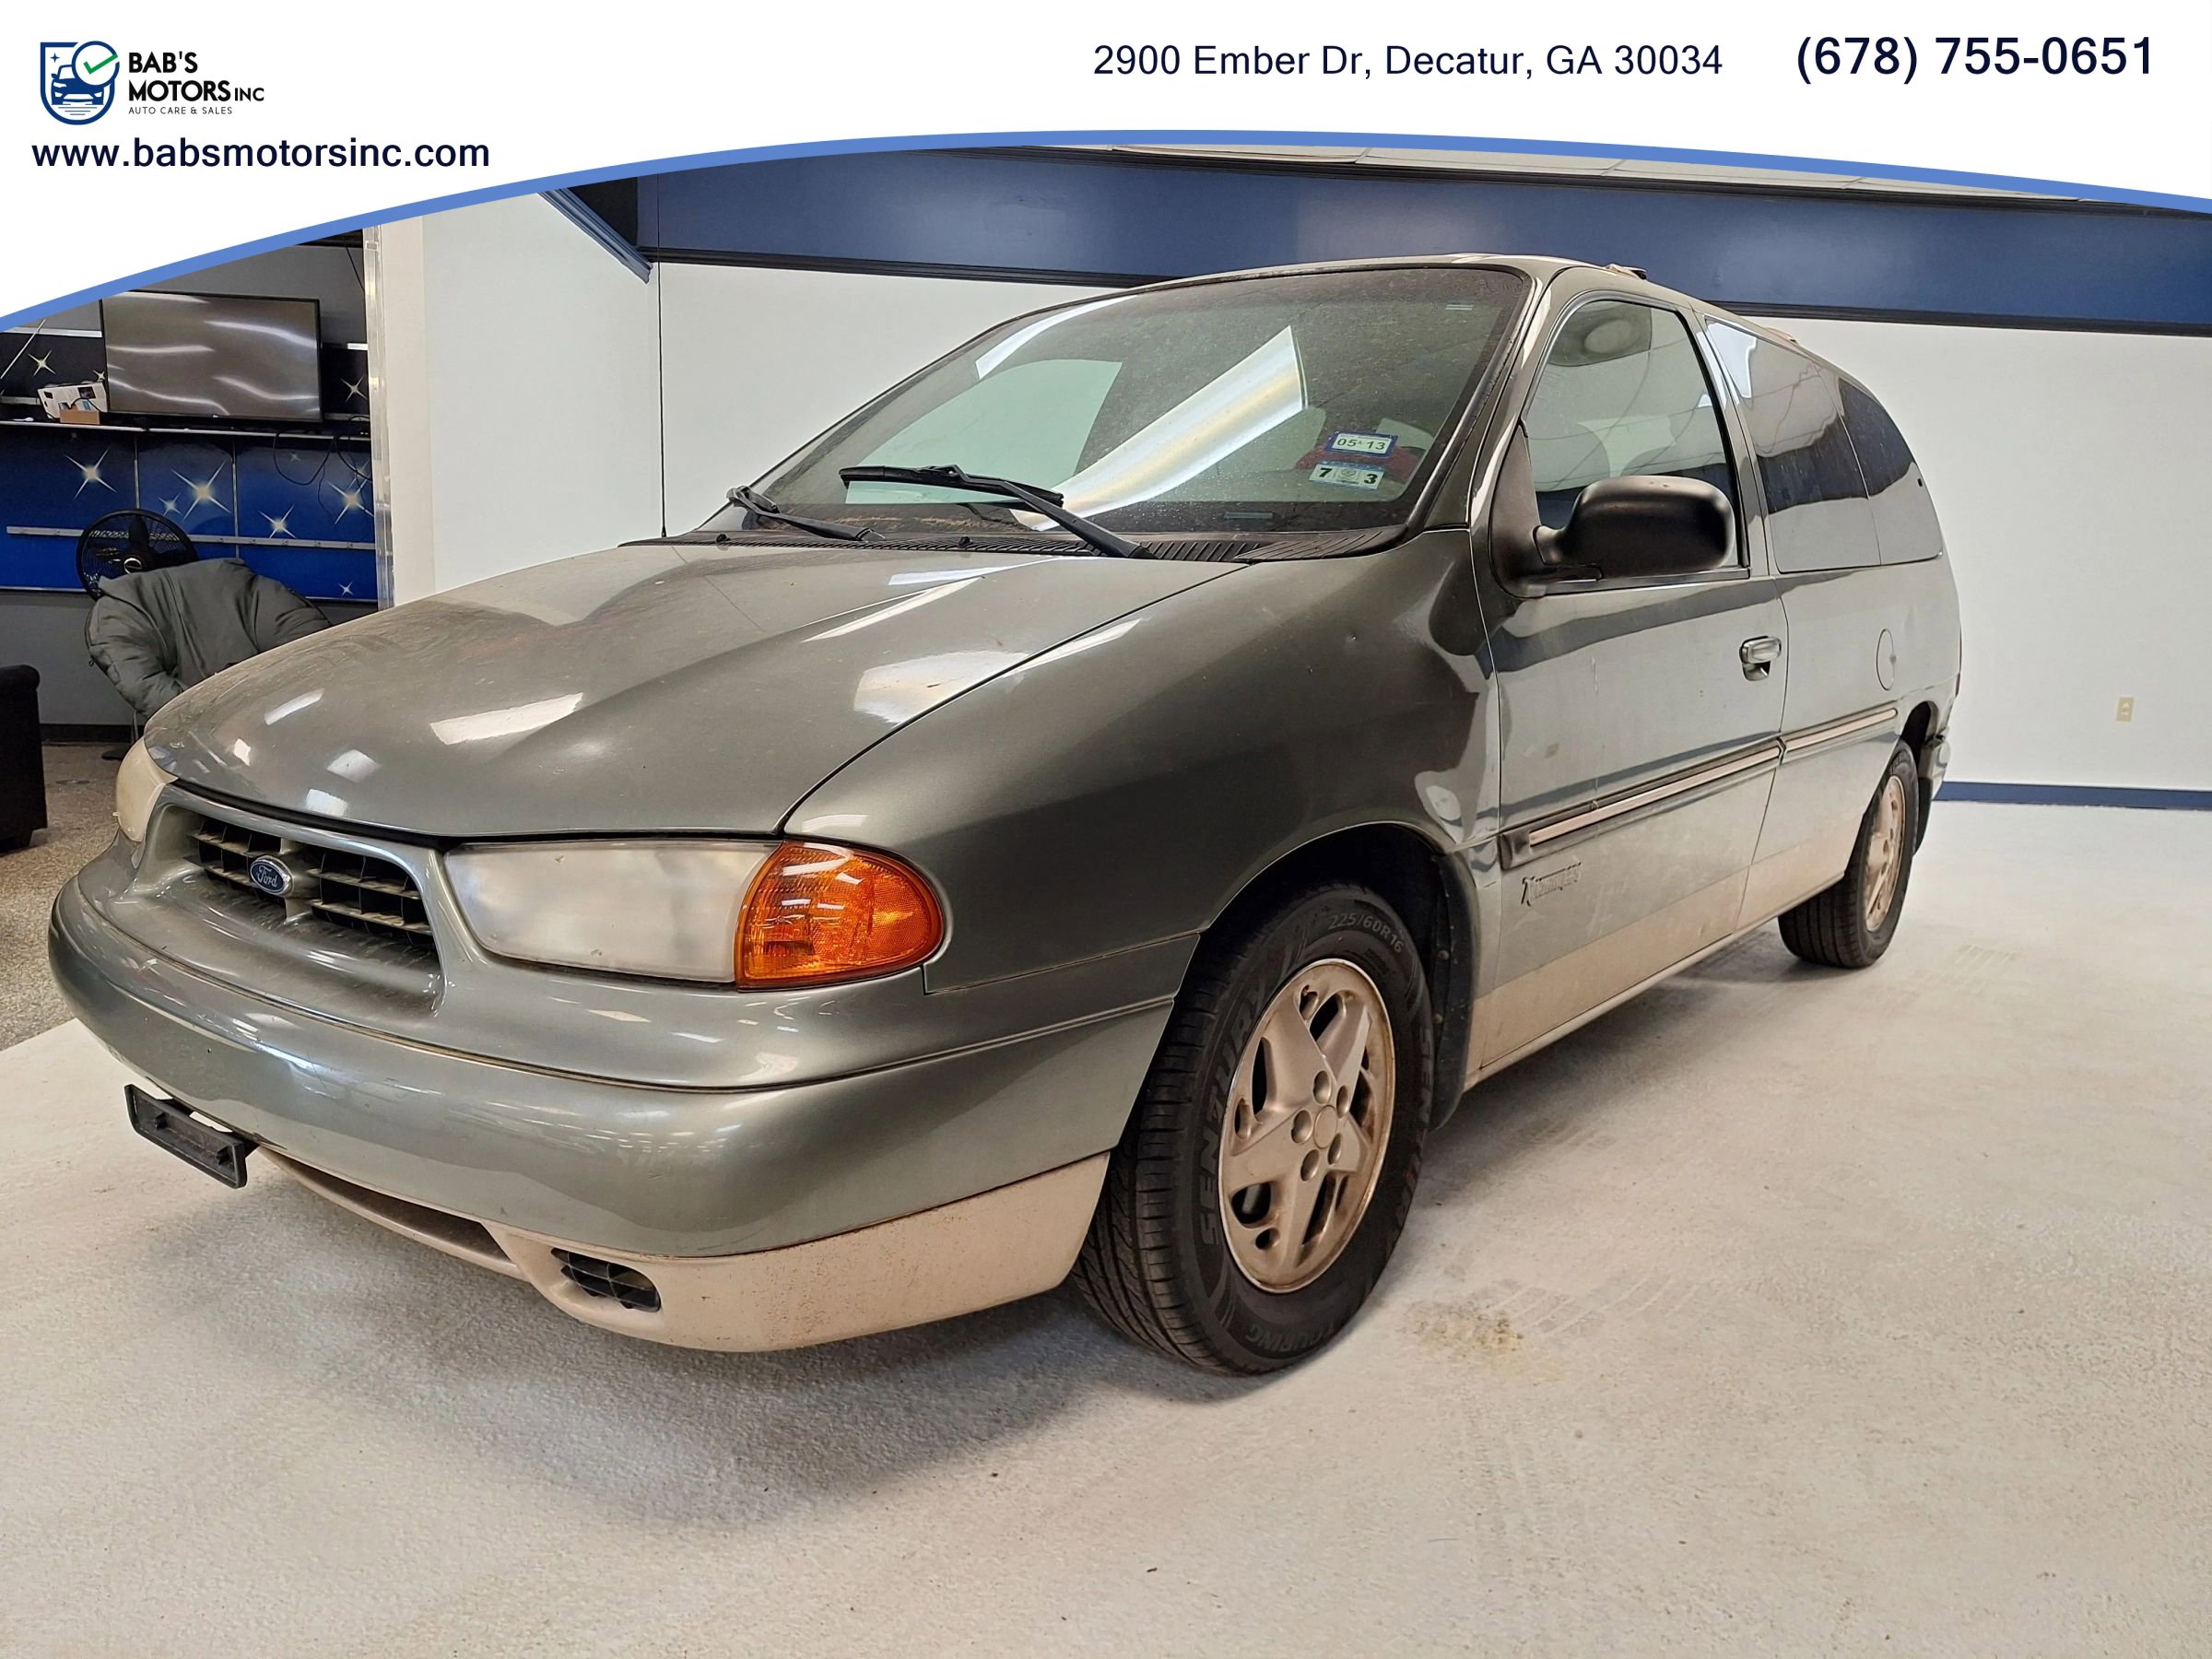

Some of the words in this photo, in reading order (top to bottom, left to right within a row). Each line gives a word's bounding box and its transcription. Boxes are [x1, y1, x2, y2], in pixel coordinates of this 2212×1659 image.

[1366, 441, 1386, 451] 13
[1318, 467, 1333, 478] 7
[1363, 473, 1378, 485] 3
[256, 865, 278, 888] Ford
[1326, 912, 1405, 954] 225/60R16
